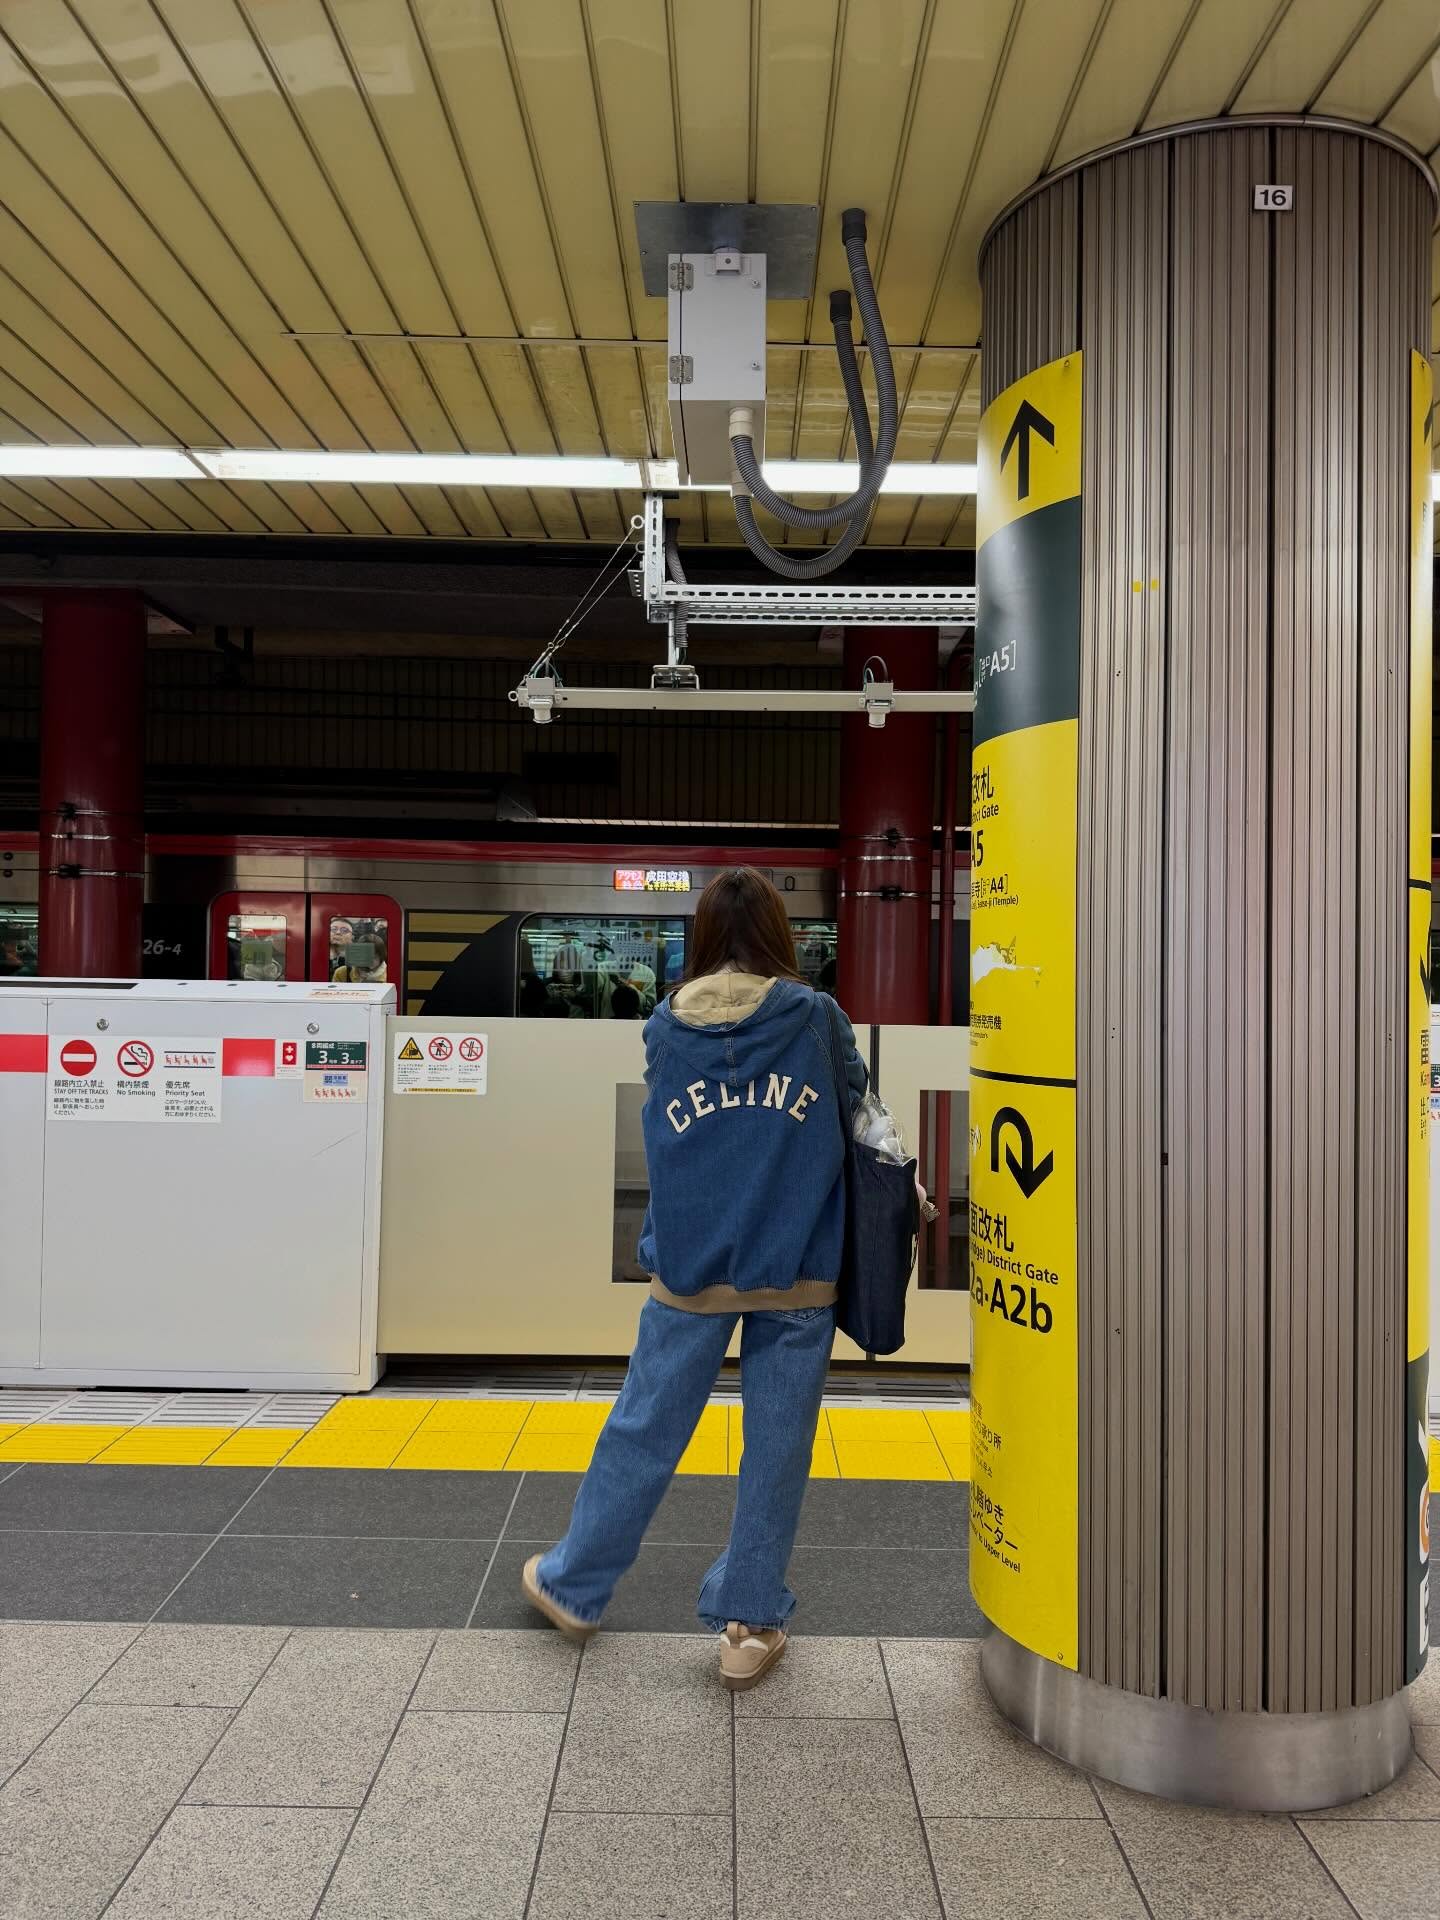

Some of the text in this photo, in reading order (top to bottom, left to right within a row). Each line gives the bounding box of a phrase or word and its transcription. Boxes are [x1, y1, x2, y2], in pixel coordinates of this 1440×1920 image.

[1260, 190, 1286, 206] 16
[982, 804, 999, 820] Gate
[54, 1079, 104, 1088] 線路内立入禁止
[117, 1080, 150, 1089] 構内禁煙
[165, 1080, 191, 1089] 優先席
[128, 1089, 156, 1097] Smoking
[665, 1072, 820, 1134] CELINE
[987, 1249, 1022, 1276] District
[1025, 1264, 1059, 1285] Gate
[1001, 1552, 1021, 1574] Level
